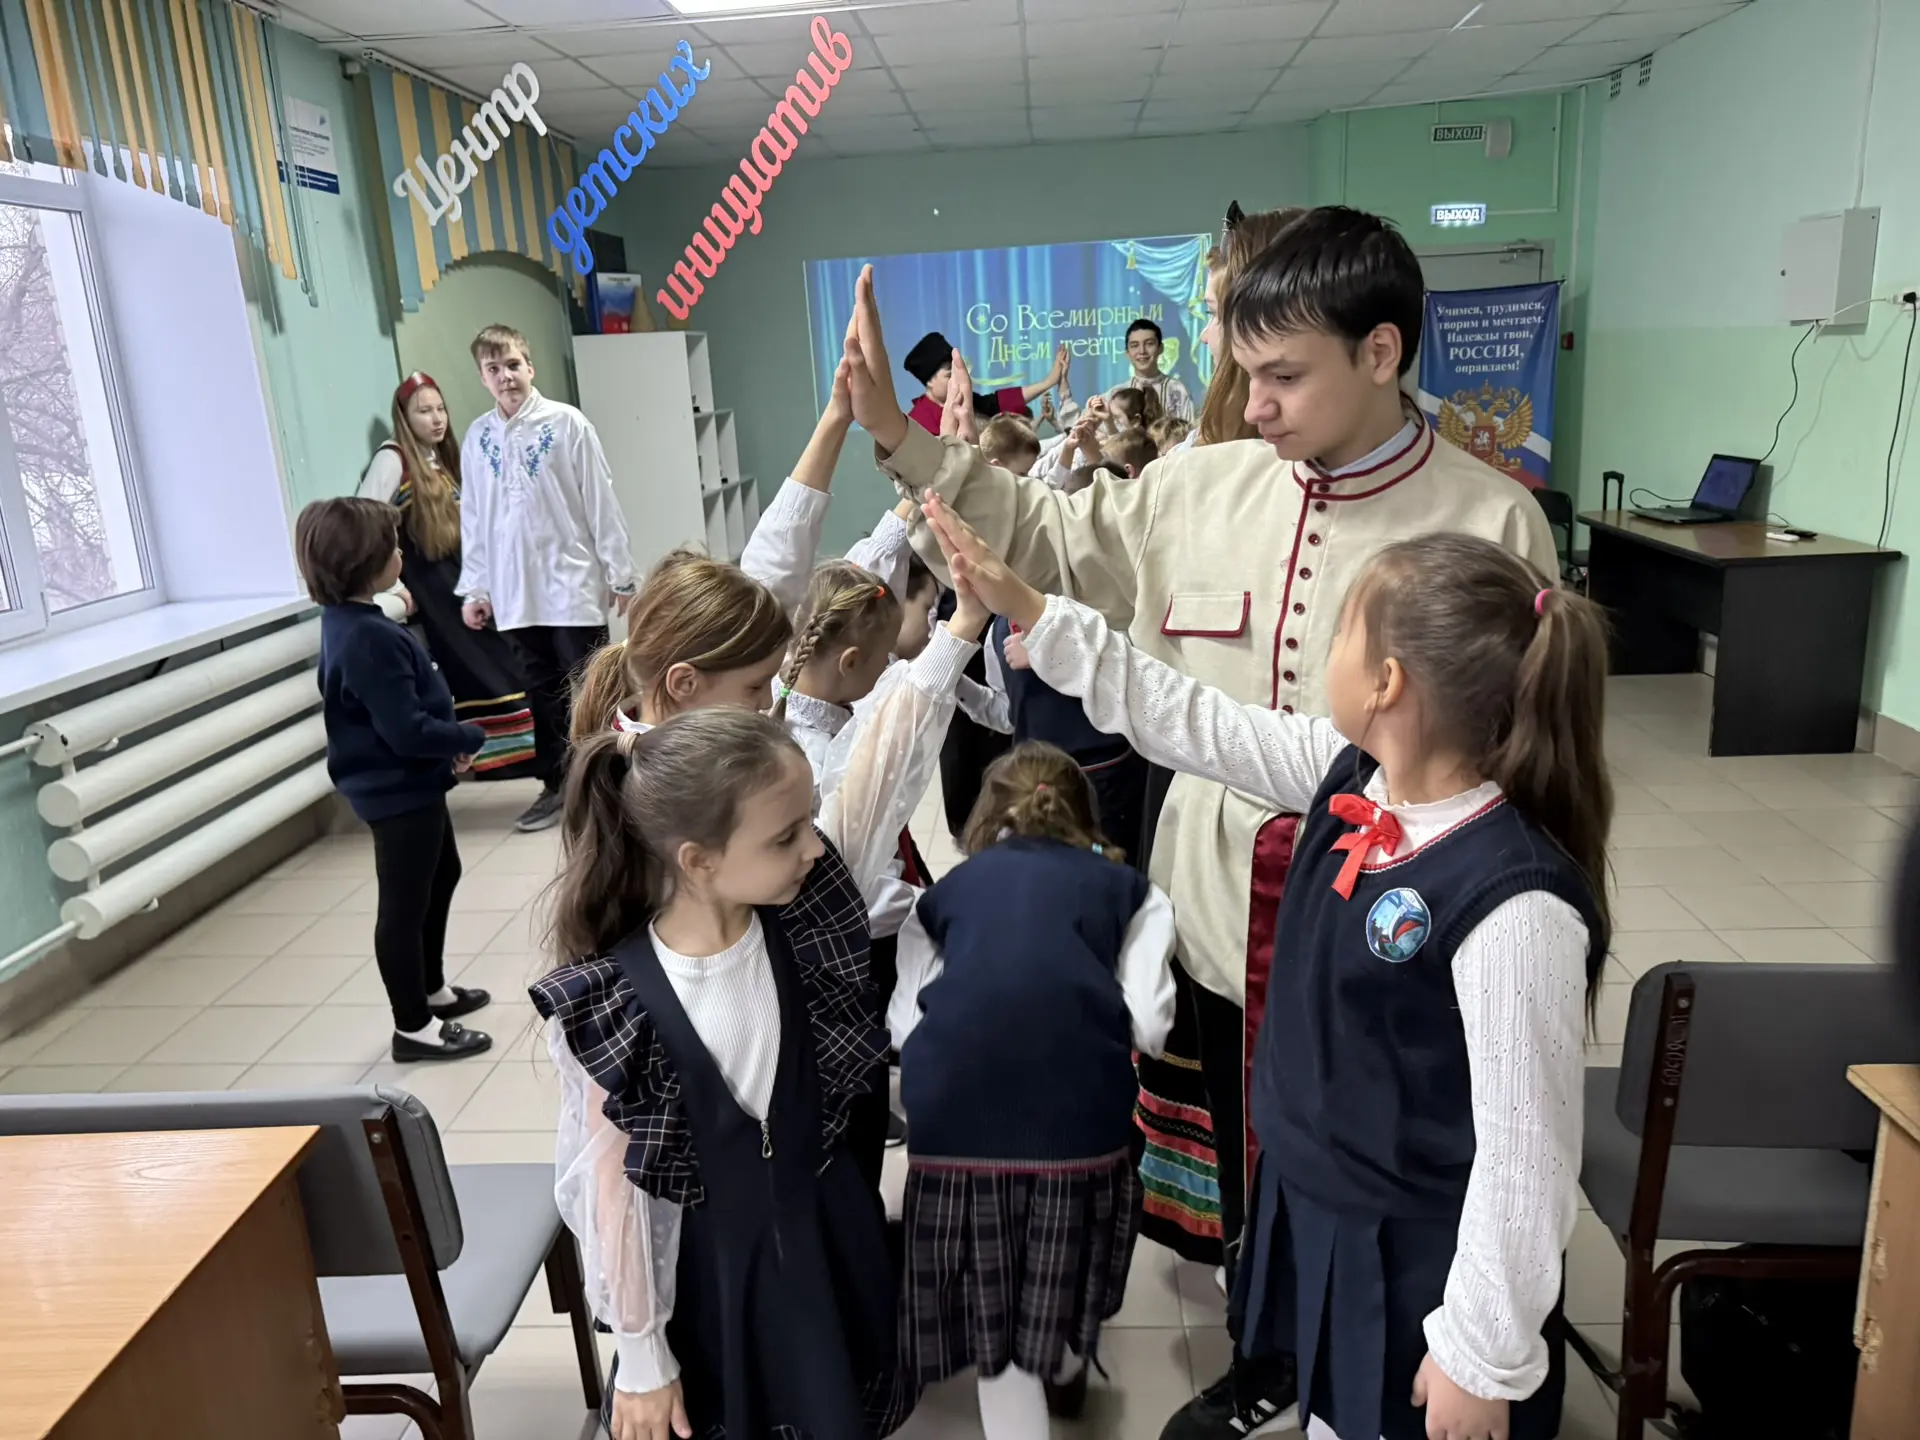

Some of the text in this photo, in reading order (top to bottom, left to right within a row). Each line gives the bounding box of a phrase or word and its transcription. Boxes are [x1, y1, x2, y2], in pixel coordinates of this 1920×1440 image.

[1436, 127, 1481, 140] ВЫХОД
[394, 61, 547, 227] Центр
[547, 39, 711, 276] детских
[656, 15, 852, 321] инициатив
[1436, 208, 1480, 221] ВЫХОД
[1437, 301, 1545, 317] Учимся, трудимся,
[966, 303, 1164, 335] Со Всемирным
[1439, 320, 1479, 331] творим
[1481, 319, 1490, 328] и
[1447, 331, 1500, 343] Надежды
[988, 335, 1127, 369] Днём театр
[1449, 343, 1525, 361] РОССИЯ,
[1455, 360, 1520, 375] оправдаем!
